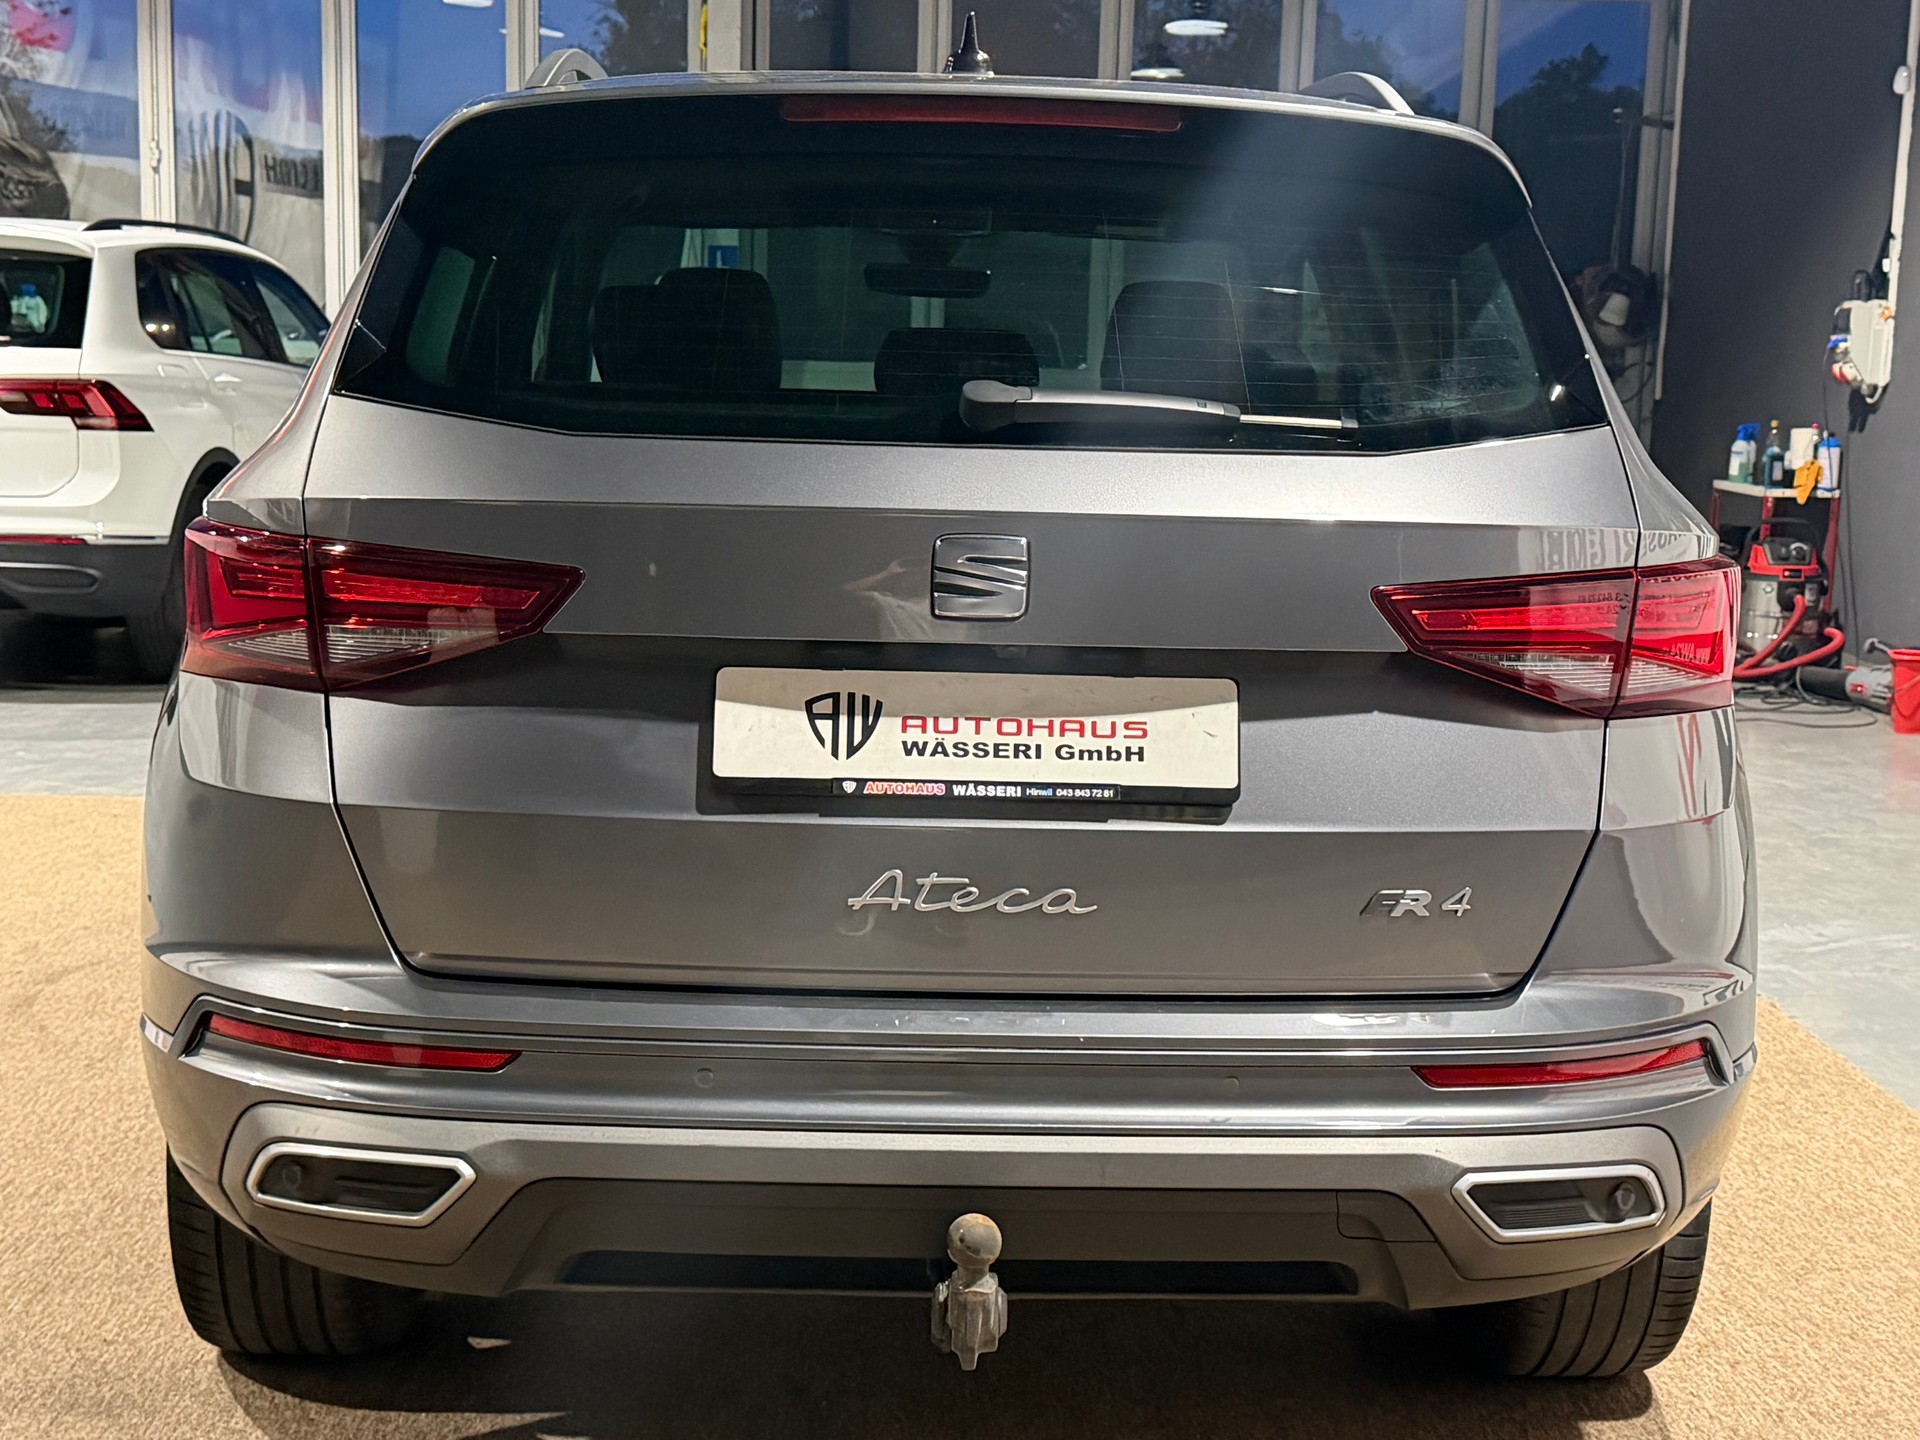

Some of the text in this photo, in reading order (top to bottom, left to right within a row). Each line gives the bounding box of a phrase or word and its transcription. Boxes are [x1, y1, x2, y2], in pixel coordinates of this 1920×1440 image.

[900, 715, 1148, 739] AUTOHAUS
[901, 737, 1145, 762] WÄSSERI GmbH
[863, 781, 946, 796] AUTOHAUS
[952, 783, 1022, 797] WÄSSERI
[1055, 788, 1074, 797] 043
[1091, 789, 1103, 798] 72
[1103, 789, 1114, 798] 81
[847, 868, 1098, 915] Ateca
[1359, 886, 1472, 917] FR 4
